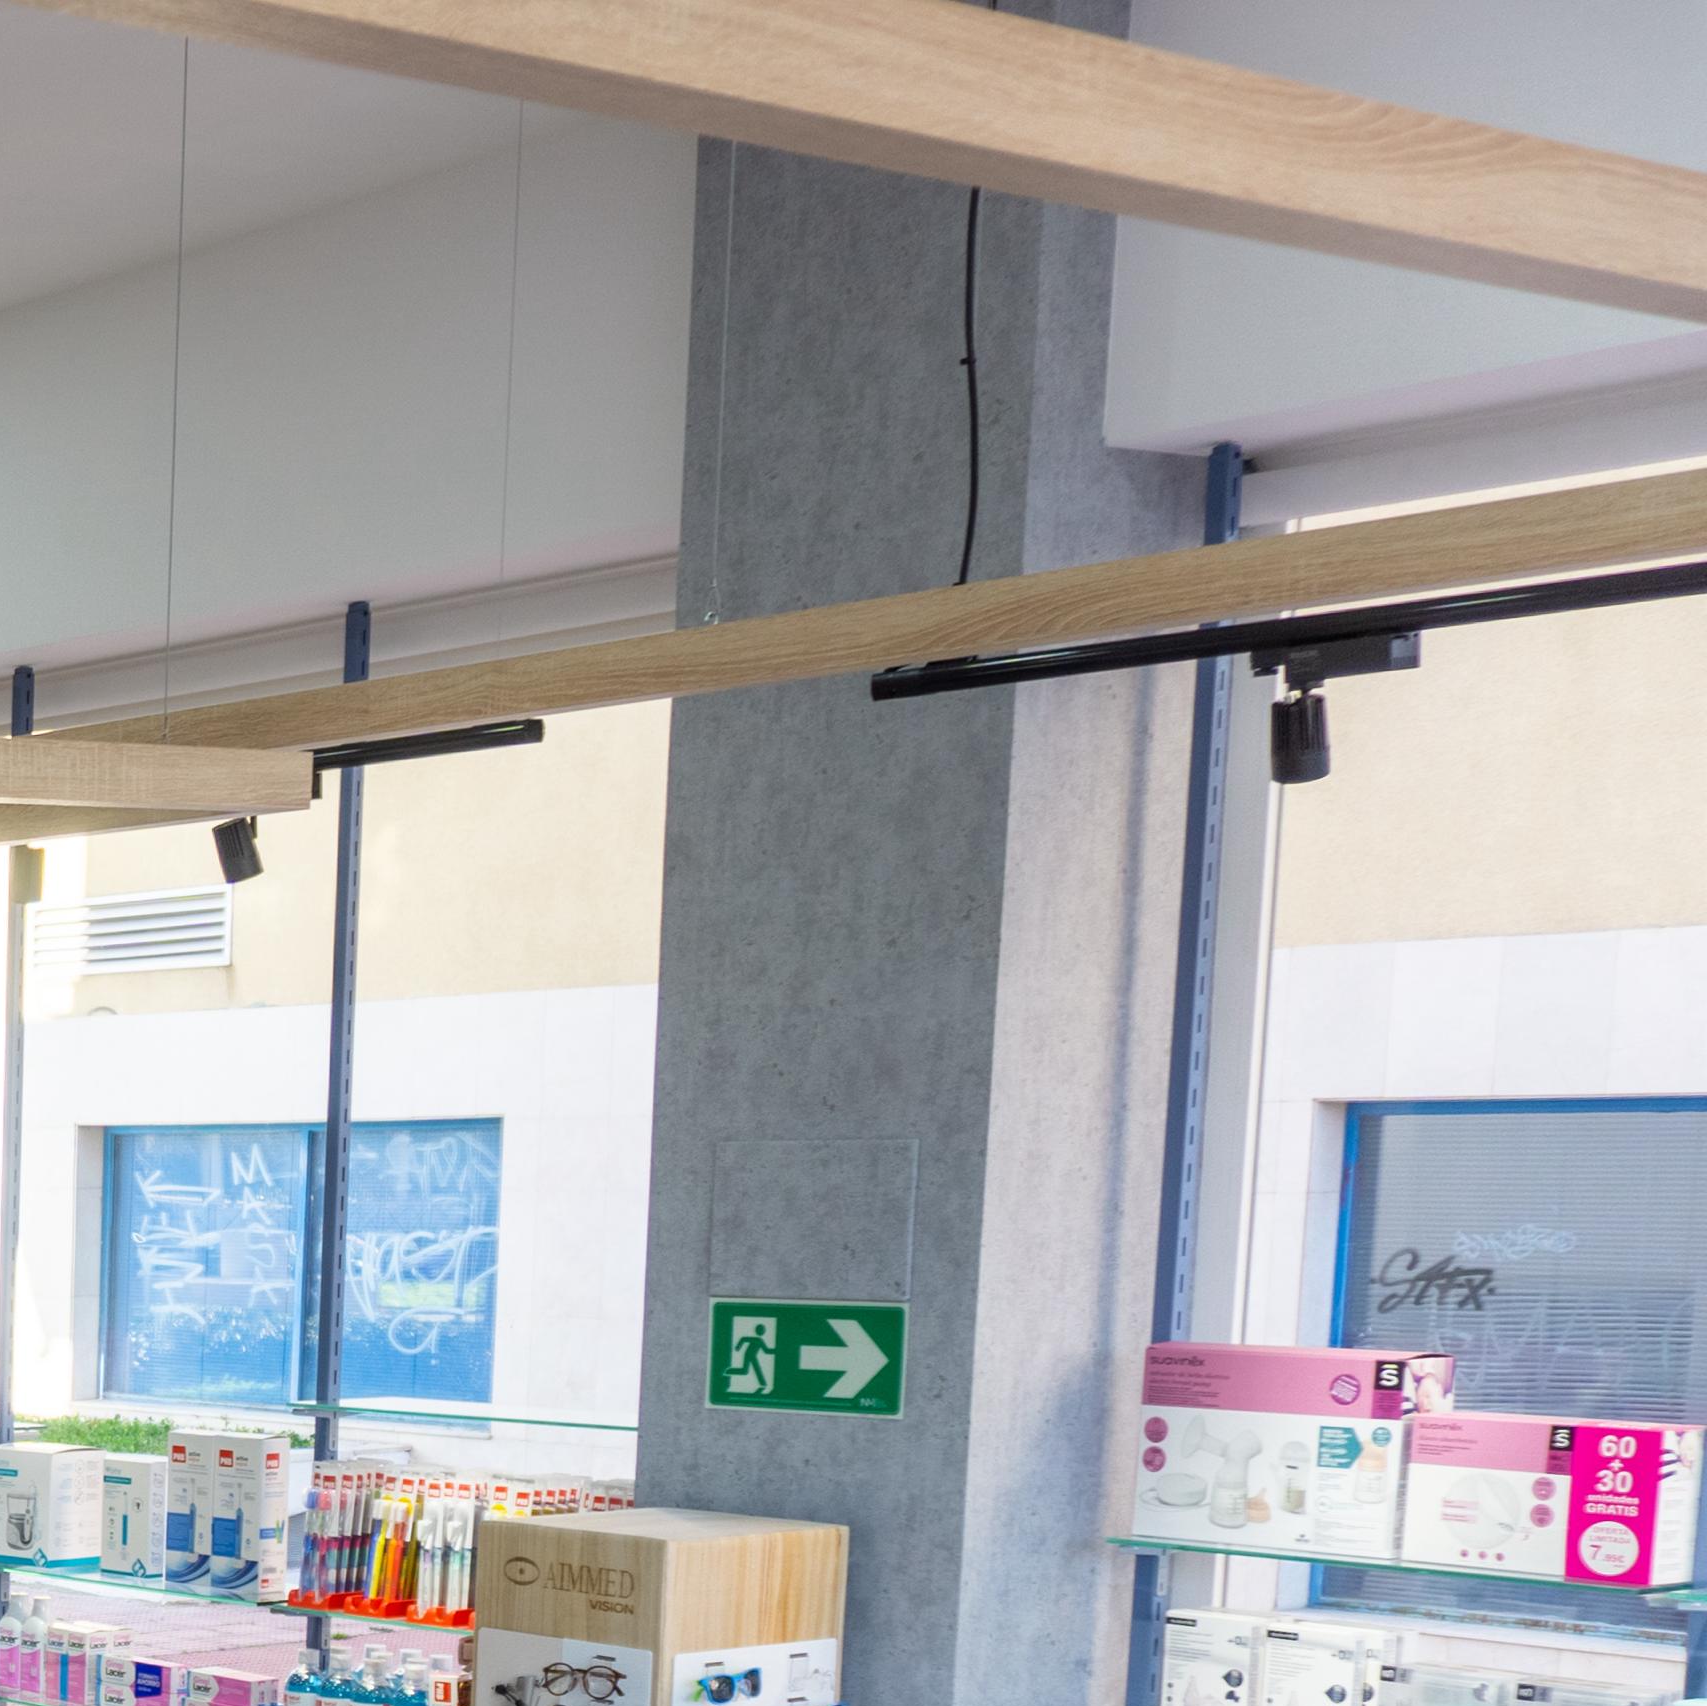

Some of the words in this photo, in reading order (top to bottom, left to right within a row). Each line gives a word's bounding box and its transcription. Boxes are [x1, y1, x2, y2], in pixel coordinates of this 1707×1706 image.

[1600, 1435, 1636, 1459] 60
[1595, 1470, 1633, 1493] 30
[1583, 1503, 1638, 1516] GRATIS
[543, 1562, 635, 1598] AIMMED
[105, 1668, 126, 1678] Lacer
[193, 1684, 212, 1693] Lacer
[104, 1694, 126, 1704] Lacer
